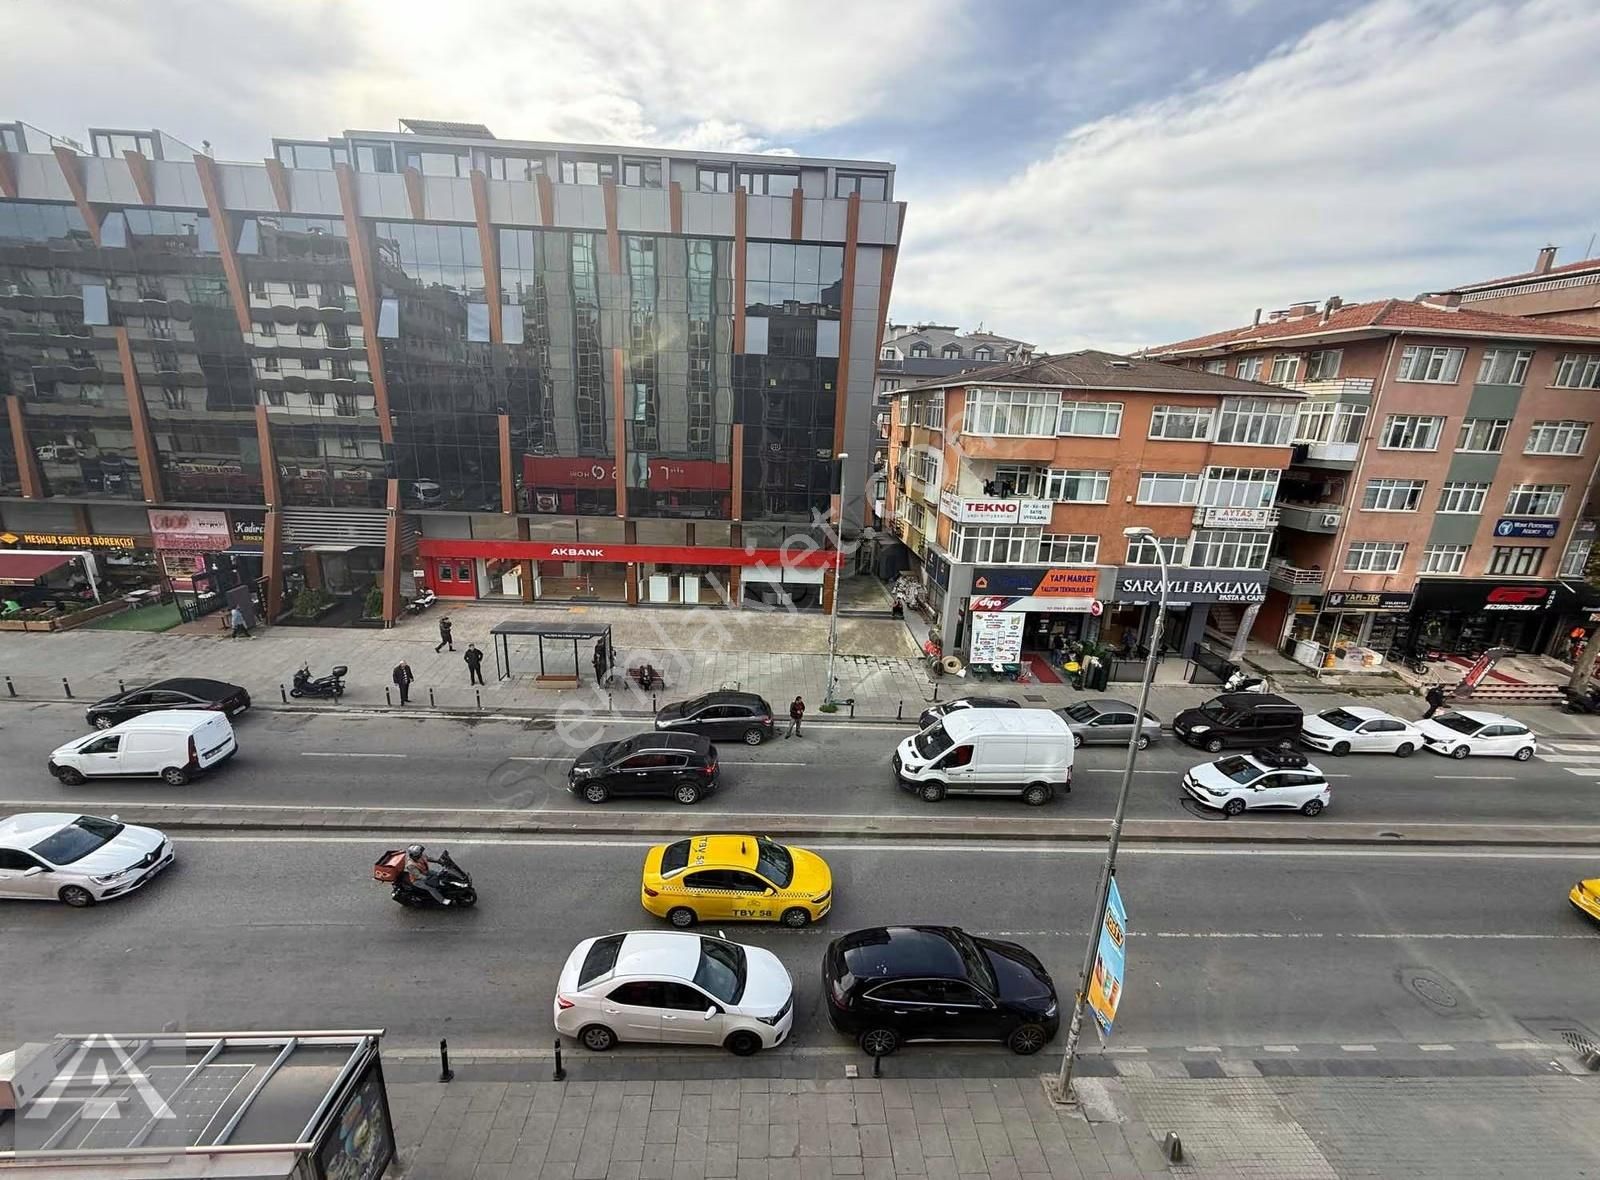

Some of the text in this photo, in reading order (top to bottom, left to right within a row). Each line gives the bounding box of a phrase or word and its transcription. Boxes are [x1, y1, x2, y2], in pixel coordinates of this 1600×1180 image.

[965, 503, 1017, 512] TEKNO
[24, 534, 58, 545] MEŞHUR
[551, 548, 604, 557] AKBANK
[1050, 574, 1096, 583] YAPI MARKET
[1192, 581, 1262, 594] BAKLAVA
[979, 597, 1002, 608] dyo
[733, 909, 772, 917] TBV 58
